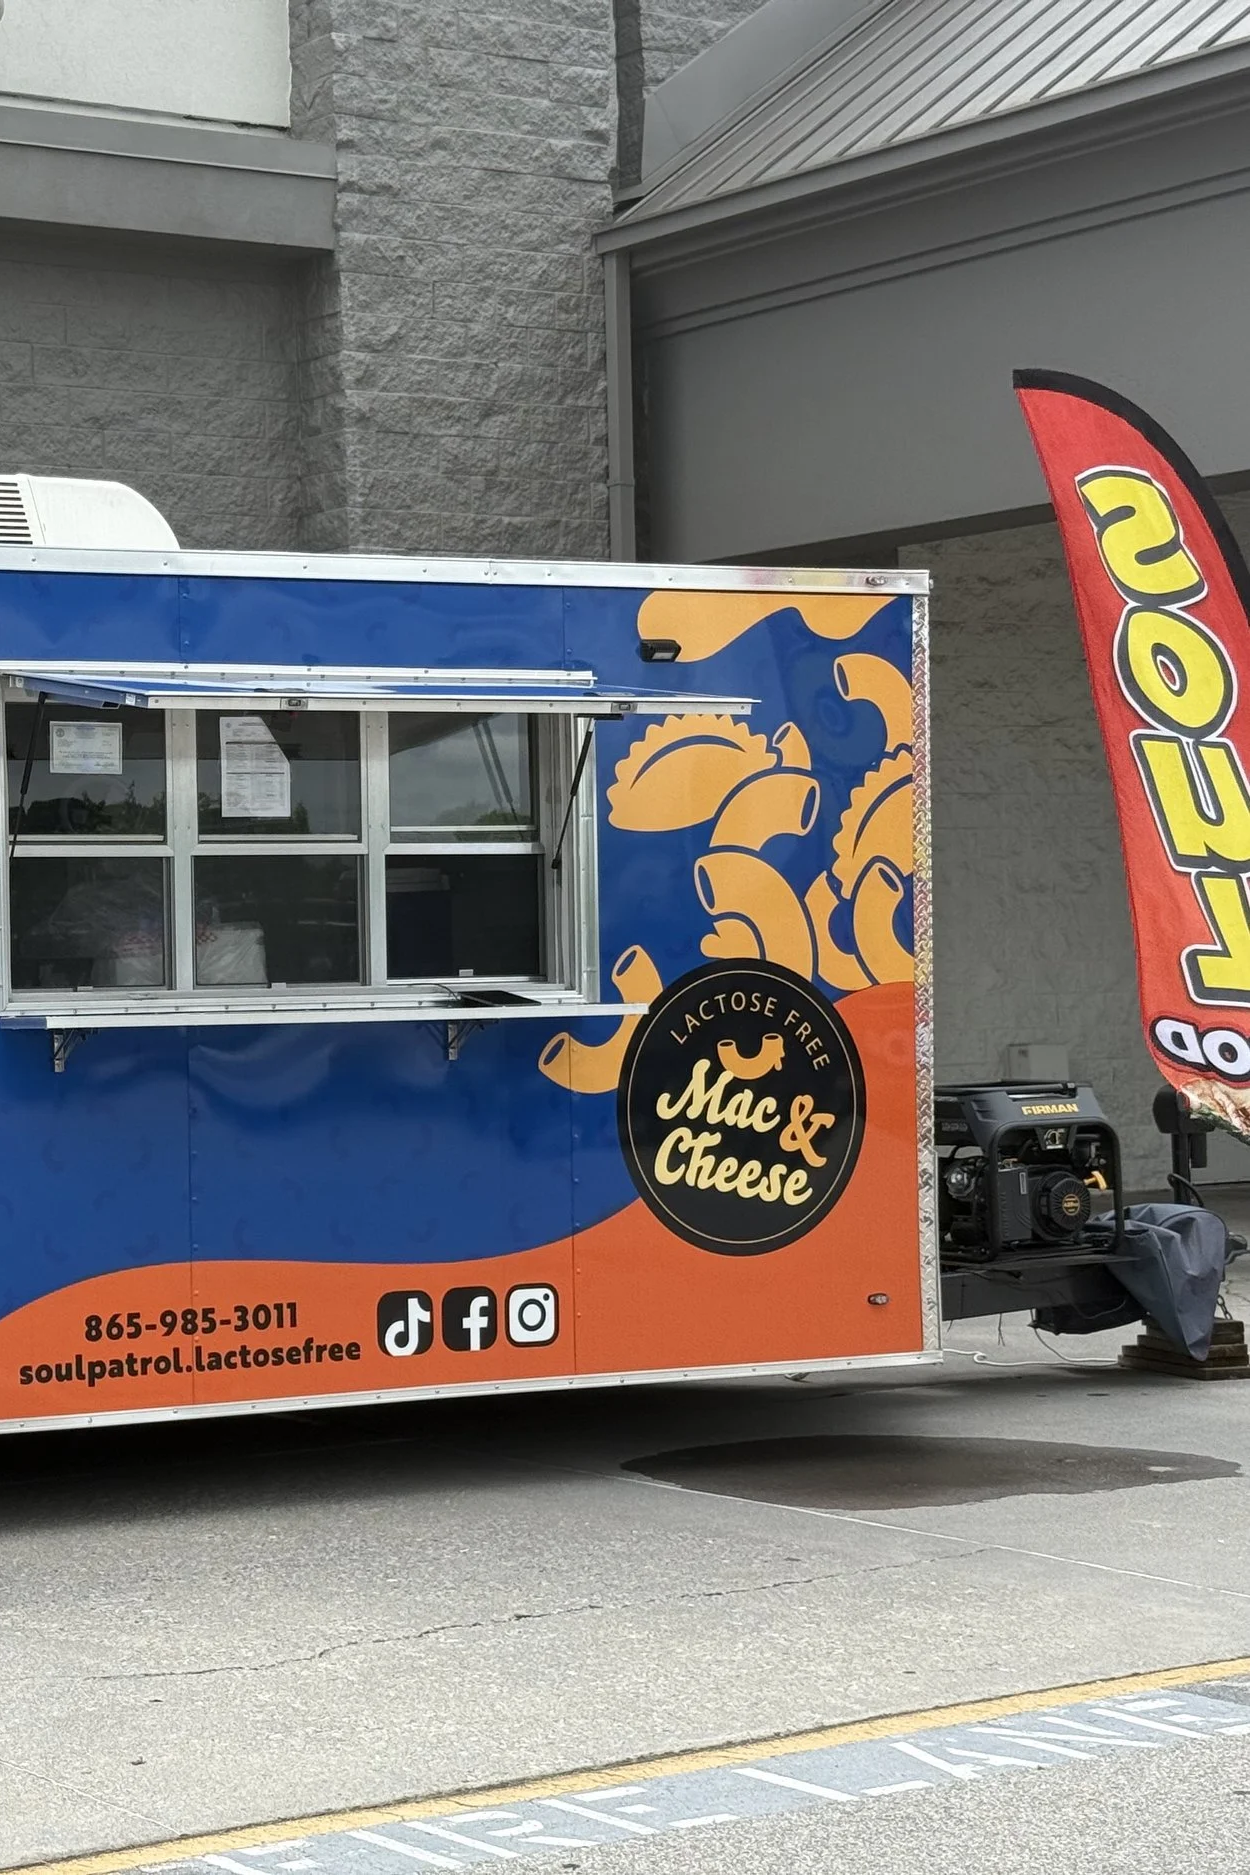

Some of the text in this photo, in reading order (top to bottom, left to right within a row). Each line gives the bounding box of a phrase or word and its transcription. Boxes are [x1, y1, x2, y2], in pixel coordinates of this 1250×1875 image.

[670, 991, 830, 1071] LACTOSE FREE
[656, 1058, 835, 1168] Mac &
[1021, 1103, 1079, 1115] FIRMAN
[654, 1127, 812, 1206] Cheese
[84, 1302, 298, 1343] 865-985-3011
[19, 1338, 361, 1387] soulpatrol.lactosefree
